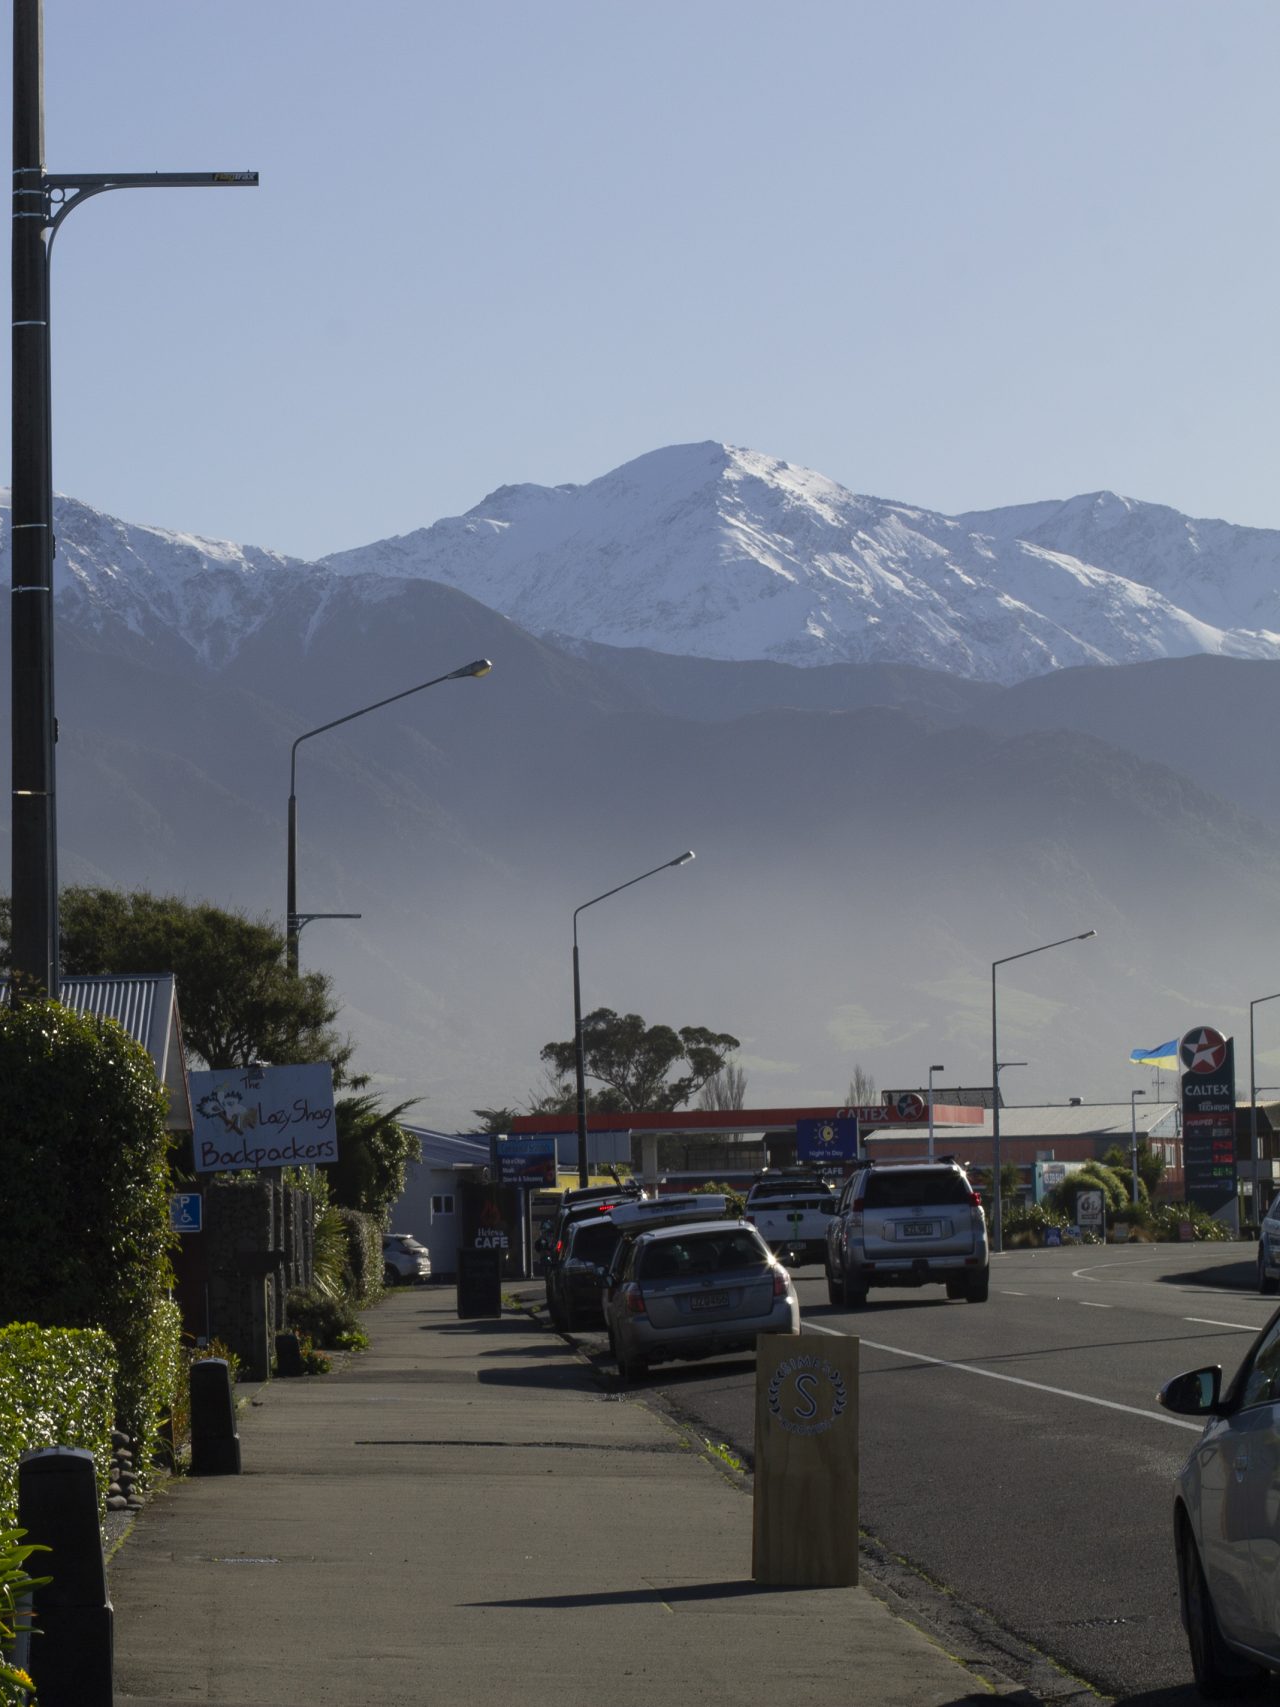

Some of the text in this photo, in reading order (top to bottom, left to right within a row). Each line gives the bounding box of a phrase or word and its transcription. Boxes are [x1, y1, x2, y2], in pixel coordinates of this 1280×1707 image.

[240, 1077, 261, 1090] The
[1185, 1084, 1230, 1096] CALTEX
[258, 1099, 332, 1134] Lazy Shag
[836, 1107, 888, 1121] CALTEX
[201, 1137, 335, 1168] Backpackers
[180, 1196, 190, 1208] P
[474, 1237, 509, 1249] CAFE
[793, 1373, 819, 1419] S
